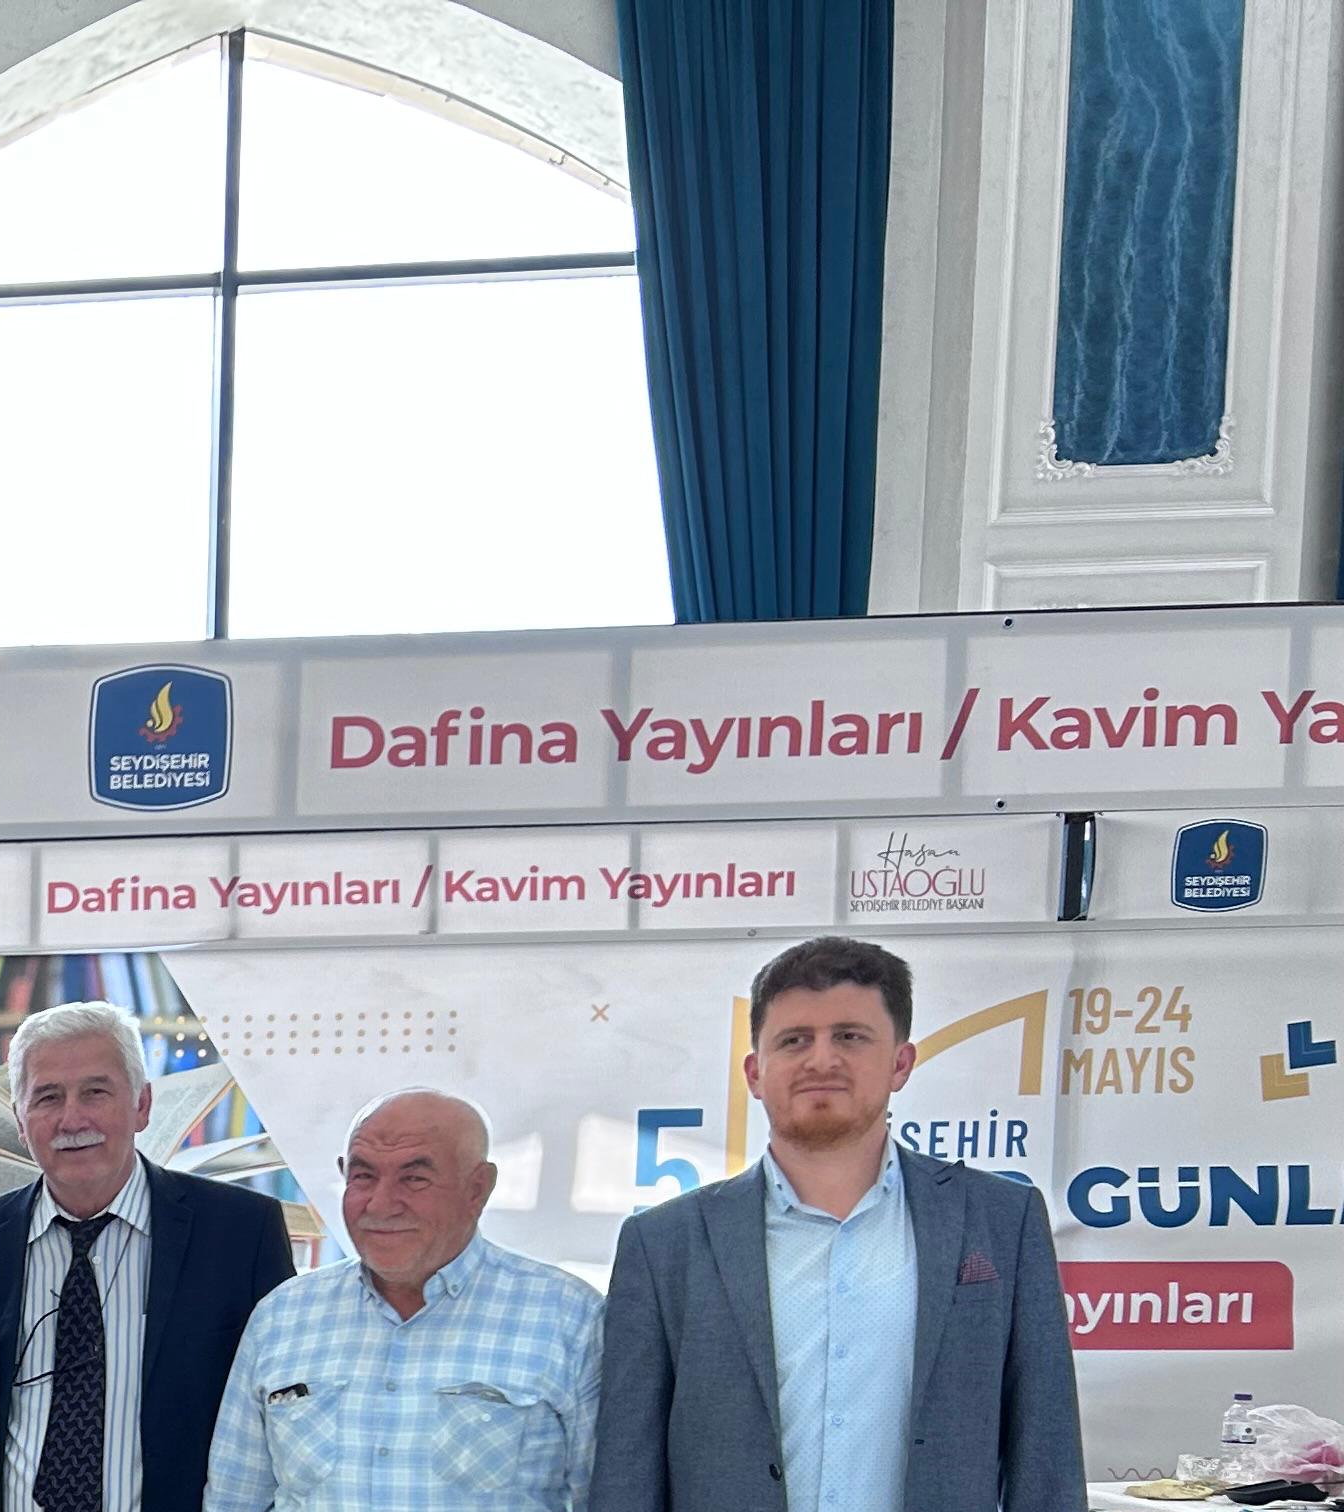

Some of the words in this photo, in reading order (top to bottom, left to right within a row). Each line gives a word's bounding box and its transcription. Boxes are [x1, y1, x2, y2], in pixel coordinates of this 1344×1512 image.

[331, 707, 577, 769] Dafina
[601, 699, 922, 774] Yayınları
[941, 688, 980, 760] /
[997, 687, 1237, 752] Kavim
[110, 771, 210, 790] BELEDİYESİ
[47, 876, 196, 914] Dafina
[210, 872, 400, 914] Yayınları
[413, 866, 433, 908] /
[444, 865, 586, 902] Kavim
[600, 863, 795, 908] Yayınları
[850, 866, 985, 898] USTAOĞLU
[1068, 985, 1193, 1035] 19-24
[1061, 1046, 1195, 1096] MAYIS
[1066, 1164, 1344, 1229] GÜNL
